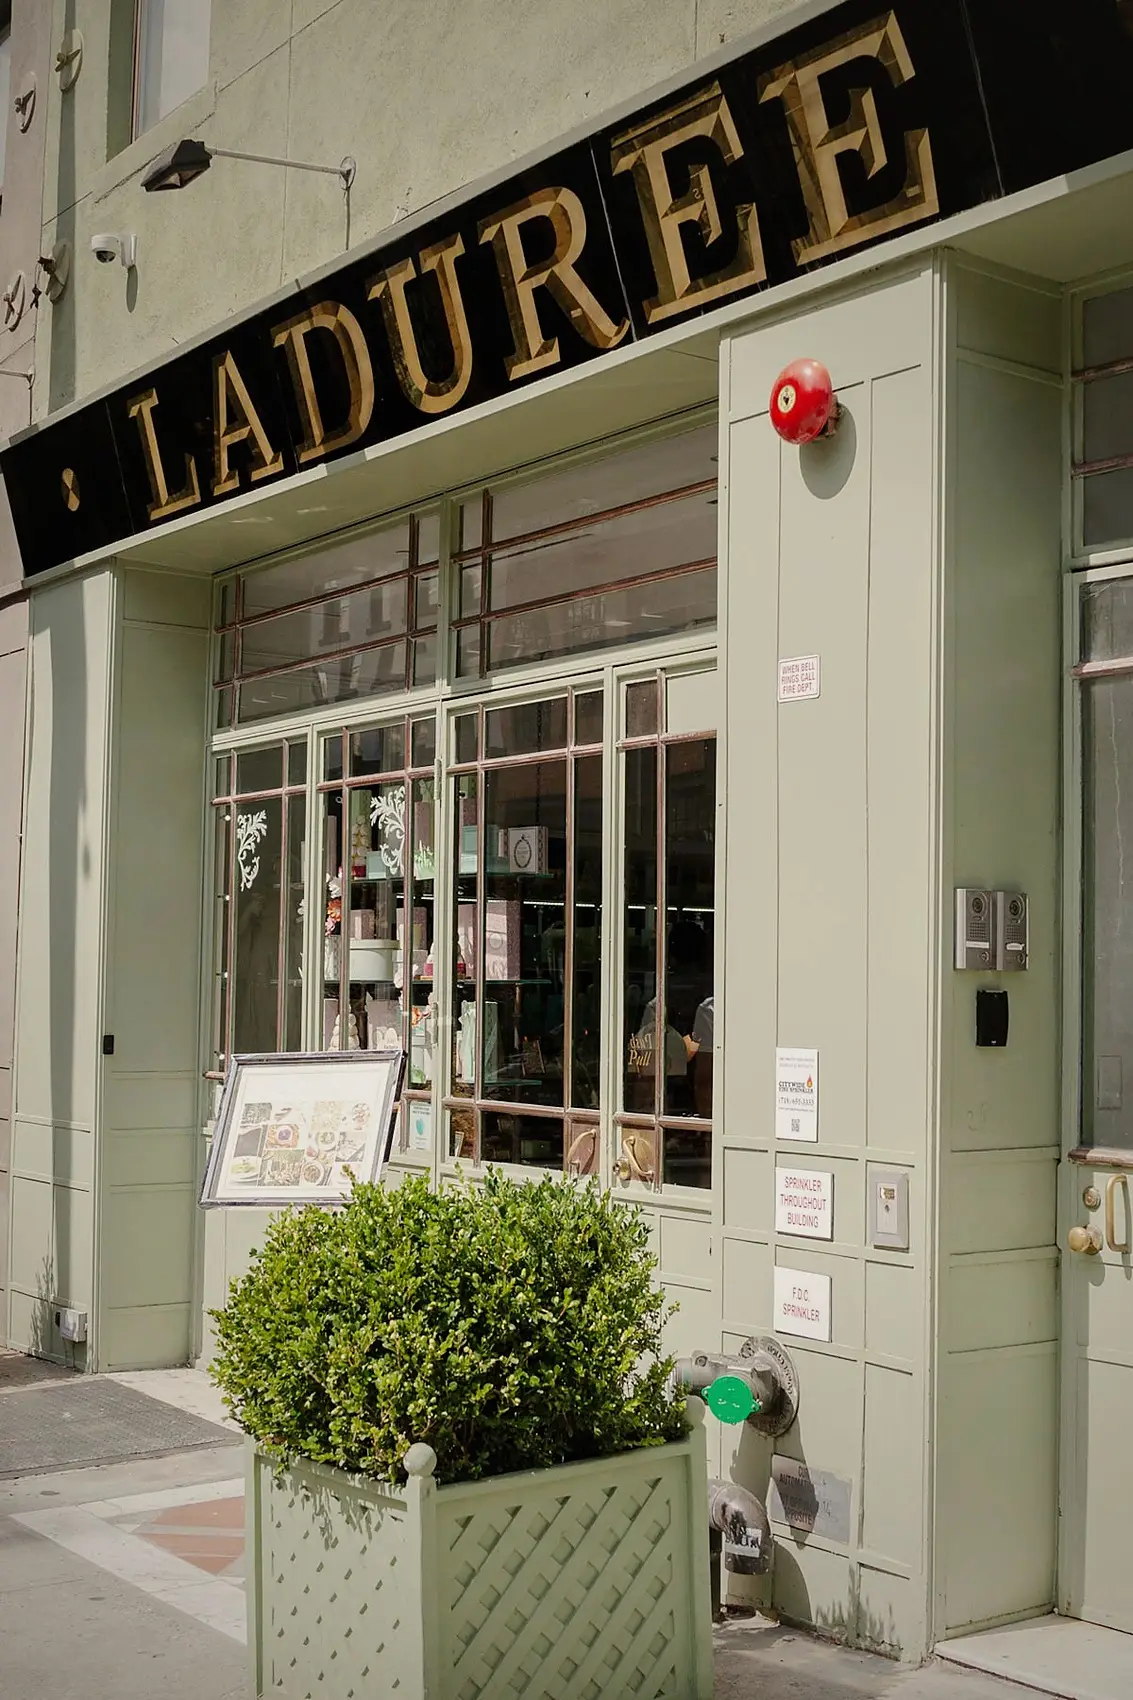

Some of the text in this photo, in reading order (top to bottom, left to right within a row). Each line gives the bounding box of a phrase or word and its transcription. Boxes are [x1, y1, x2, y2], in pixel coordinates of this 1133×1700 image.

[782, 661, 815, 675] WHEN BELL
[782, 671, 815, 685] RINGS CALL
[783, 684, 796, 694] FIRE
[628, 1050, 652, 1066] Pull
[785, 1176, 822, 1192] SPRINKLER
[780, 1193, 826, 1211] THROUGHOUT
[787, 1212, 819, 1229] BUILDING
[782, 1303, 820, 1322] SPRINKLER
